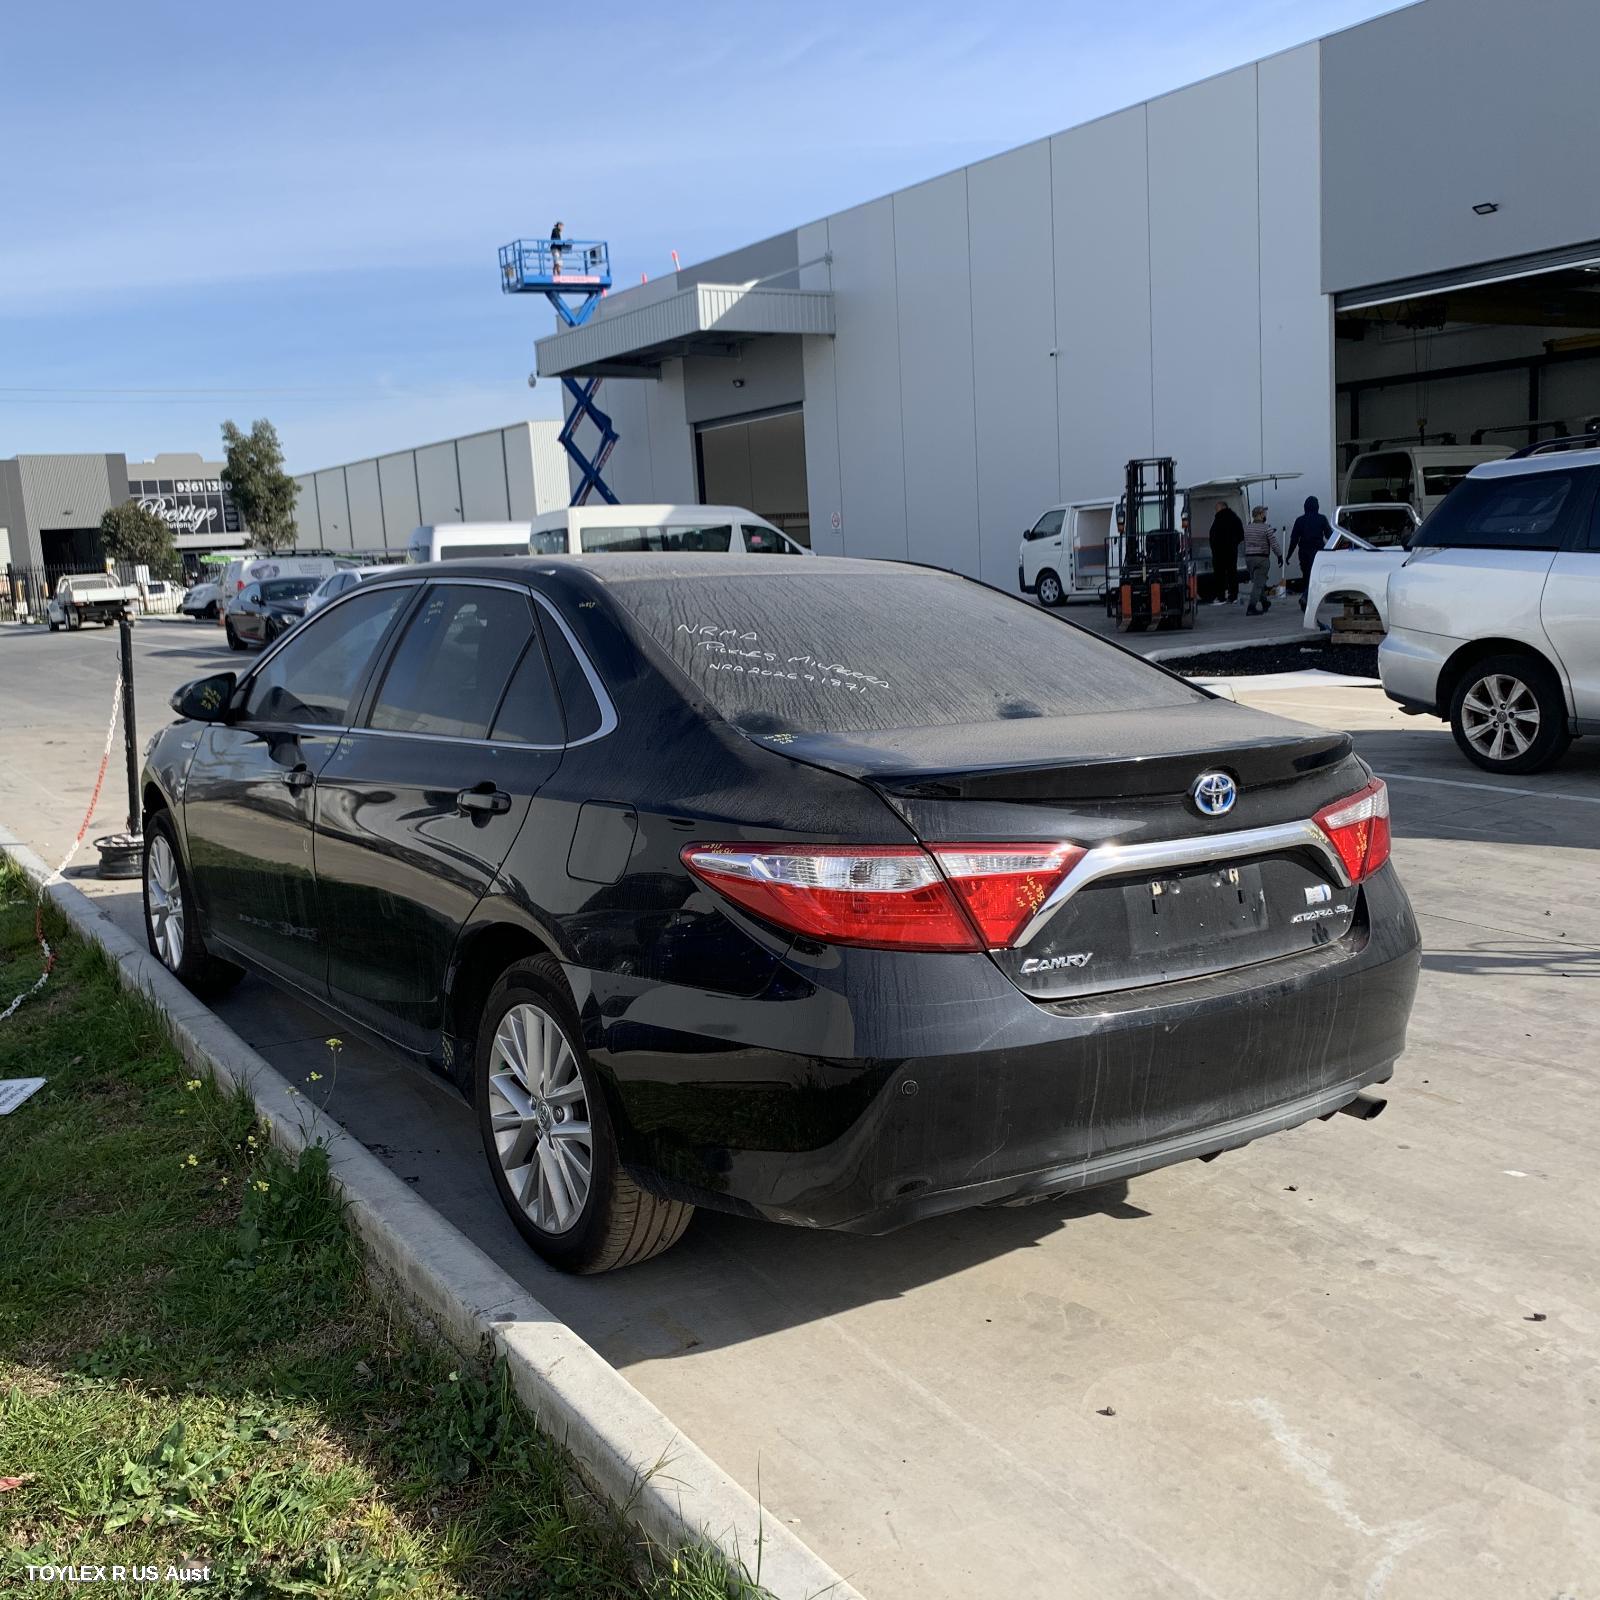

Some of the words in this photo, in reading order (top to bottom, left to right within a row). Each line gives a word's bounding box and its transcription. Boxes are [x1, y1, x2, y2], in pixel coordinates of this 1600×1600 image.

[176, 481, 204, 493] 9361
[137, 496, 218, 532] Prestige
[677, 623, 757, 642] NRMA
[1290, 907, 1334, 923] ATARA
[1020, 952, 1094, 974] CAMRY
